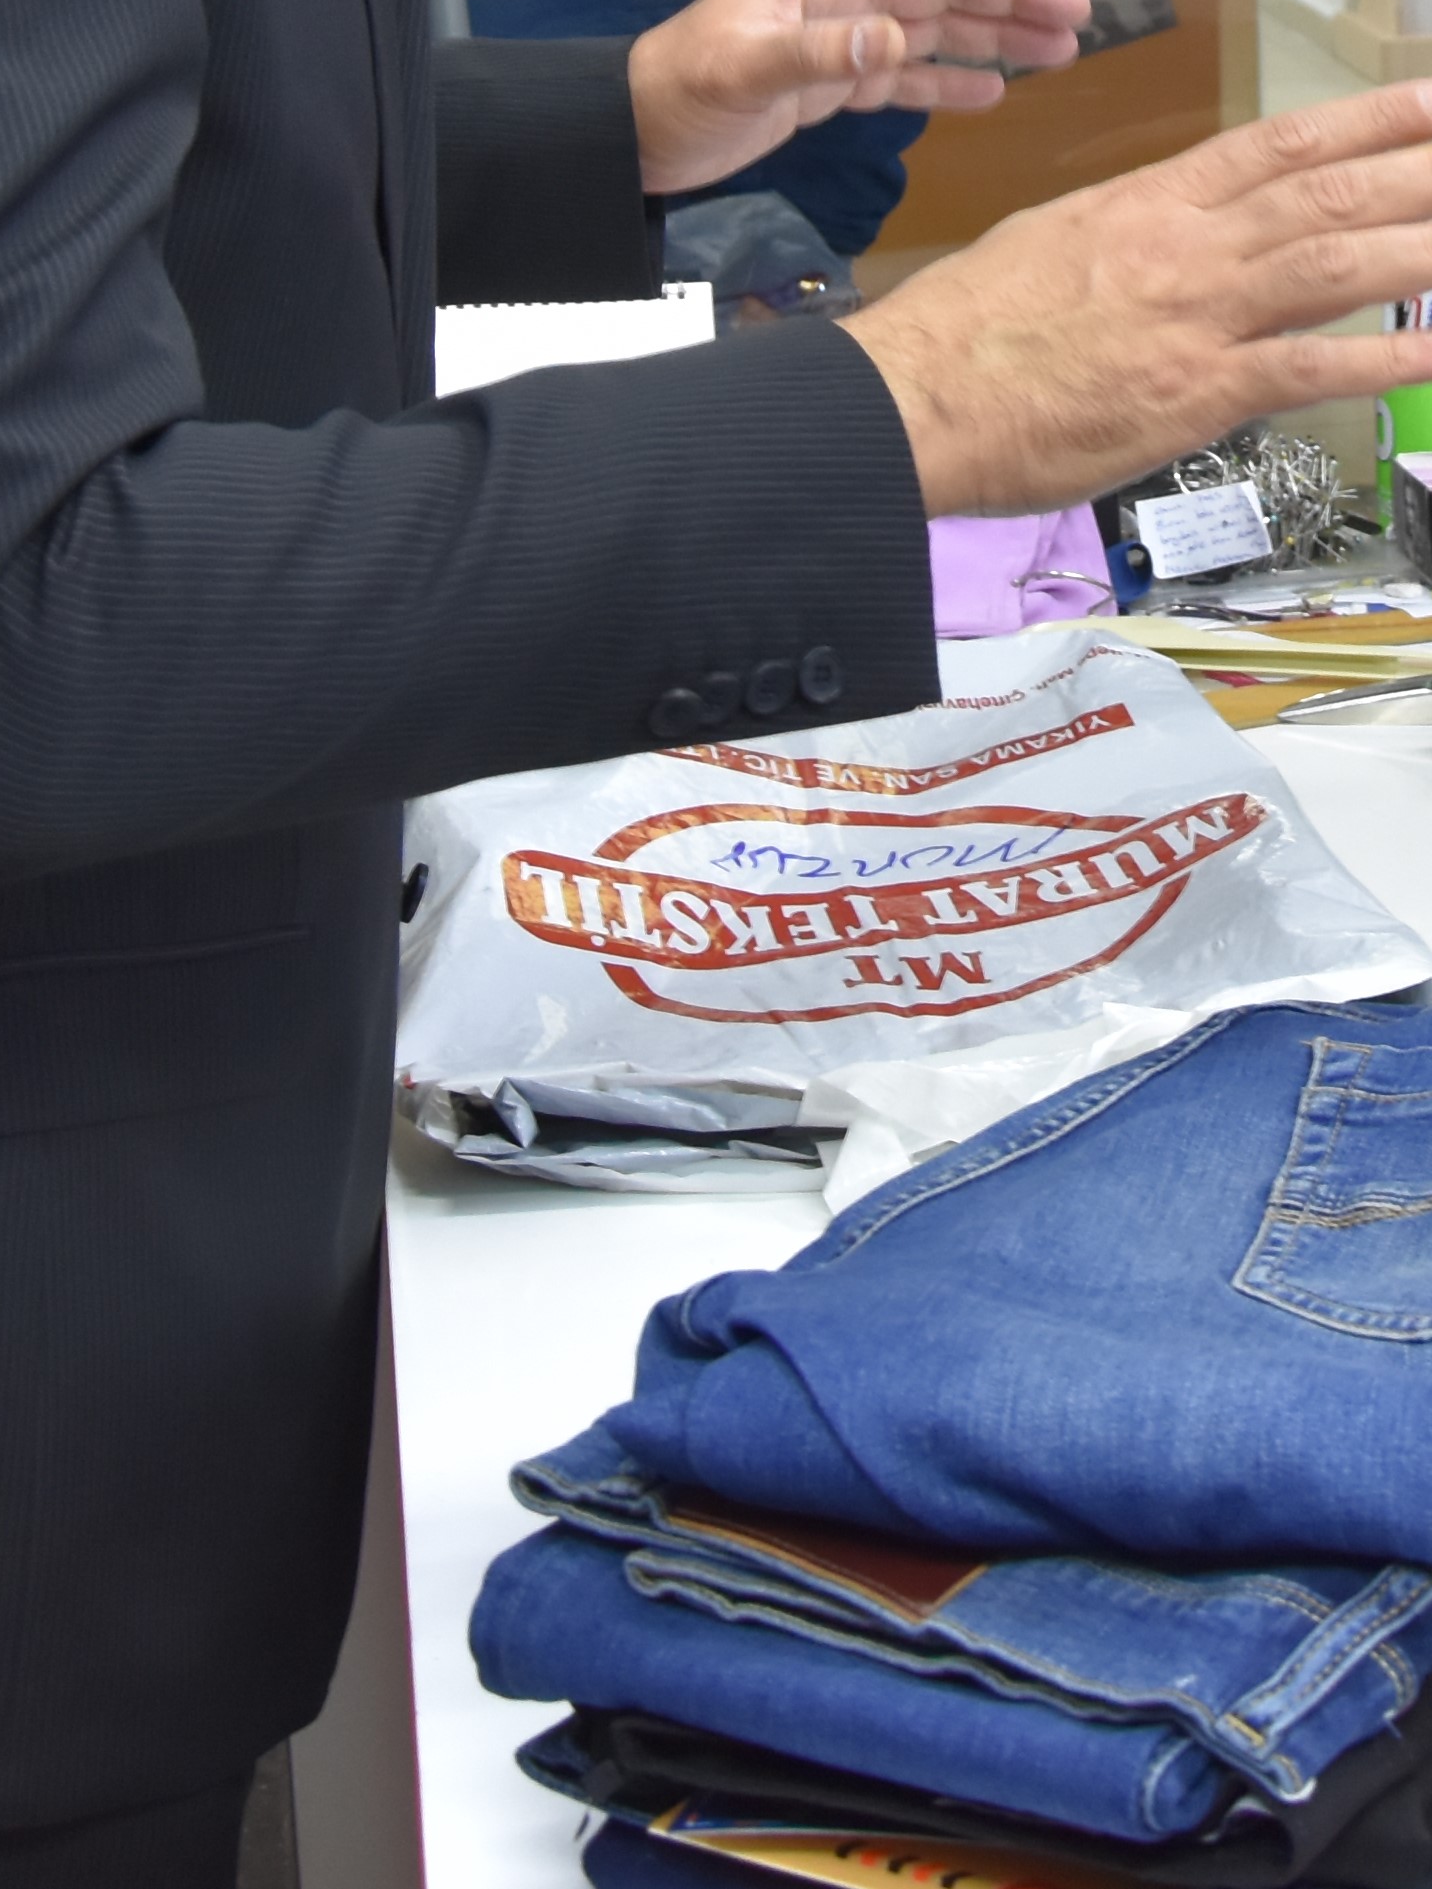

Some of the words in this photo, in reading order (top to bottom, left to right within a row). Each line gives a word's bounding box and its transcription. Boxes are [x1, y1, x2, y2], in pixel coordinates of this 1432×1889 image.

[971, 712, 1113, 767] YIKAMA
[813, 761, 862, 785] VE
[920, 802, 1232, 930] MURAT
[519, 861, 904, 957] TEKSTİL
[842, 952, 990, 991] MT
